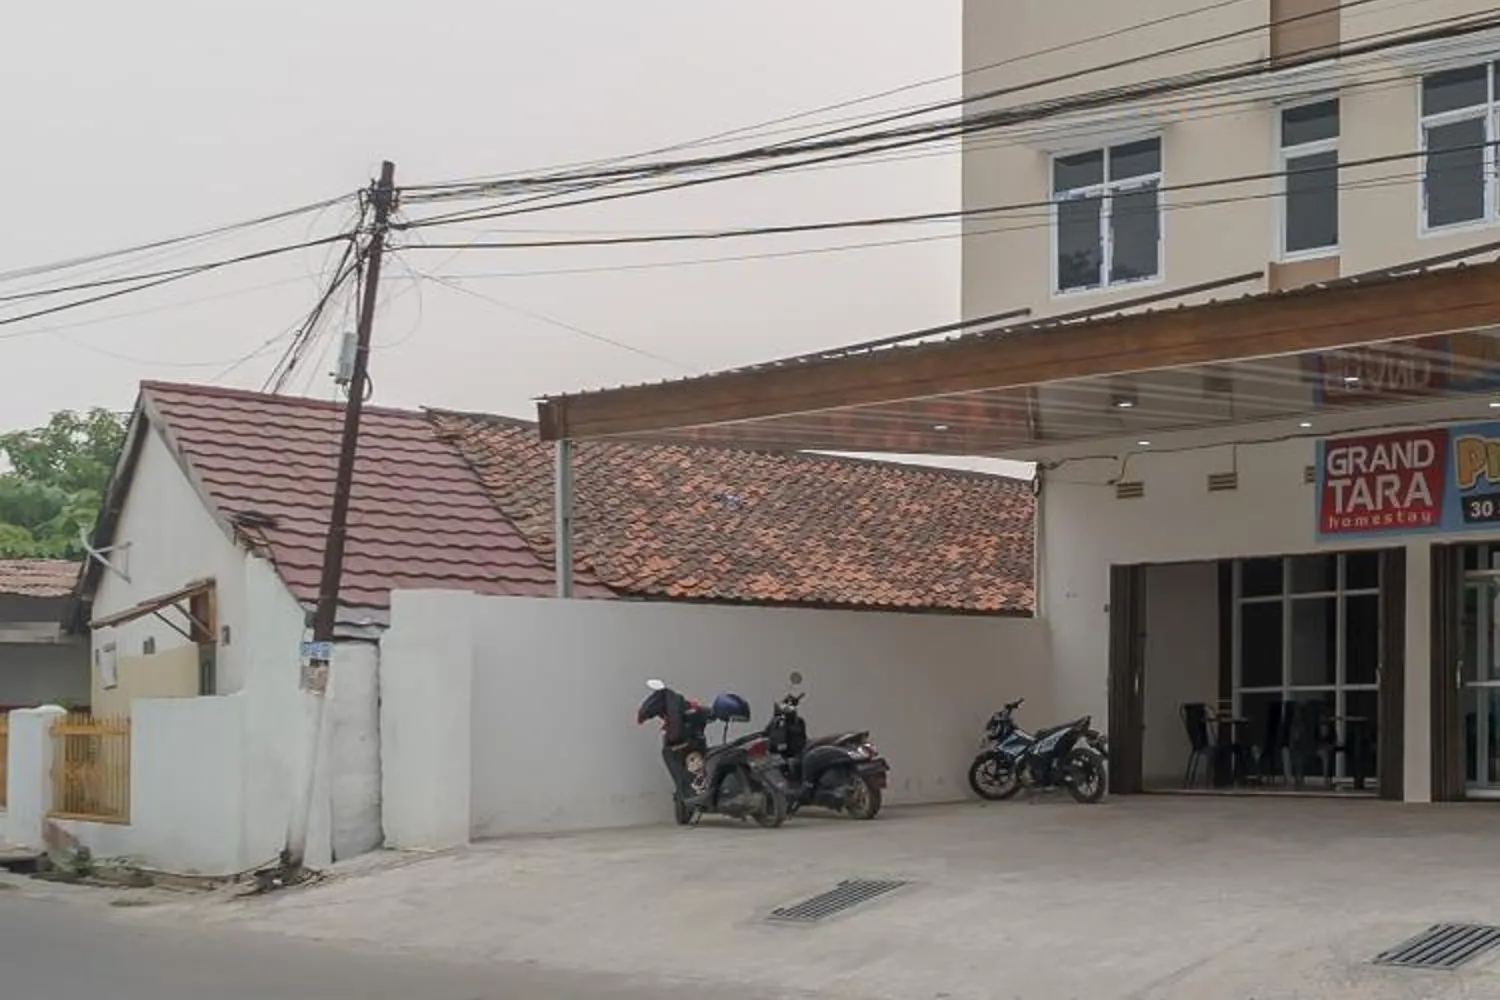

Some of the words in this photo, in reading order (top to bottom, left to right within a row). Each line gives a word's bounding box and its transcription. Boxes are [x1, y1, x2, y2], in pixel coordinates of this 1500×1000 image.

[1327, 438, 1435, 476] GRAND
[1327, 470, 1434, 515] TARA
[1328, 510, 1432, 529] homestay
[1471, 500, 1494, 518] 30
